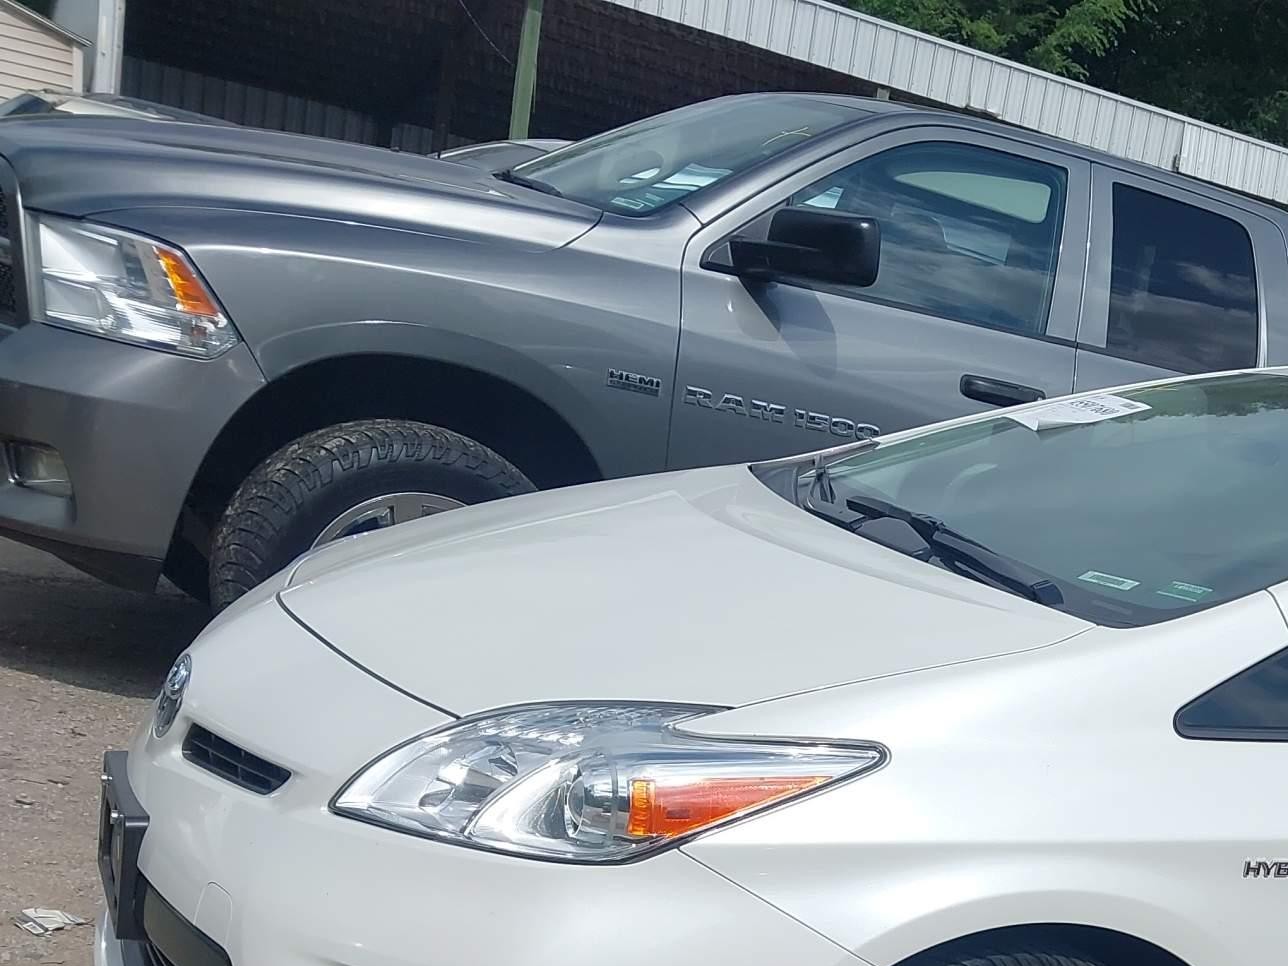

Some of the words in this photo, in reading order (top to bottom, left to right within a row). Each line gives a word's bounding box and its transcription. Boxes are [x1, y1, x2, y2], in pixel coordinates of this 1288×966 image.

[608, 368, 661, 389] HEMI
[683, 385, 786, 425] RAM
[793, 408, 881, 441] 1500
